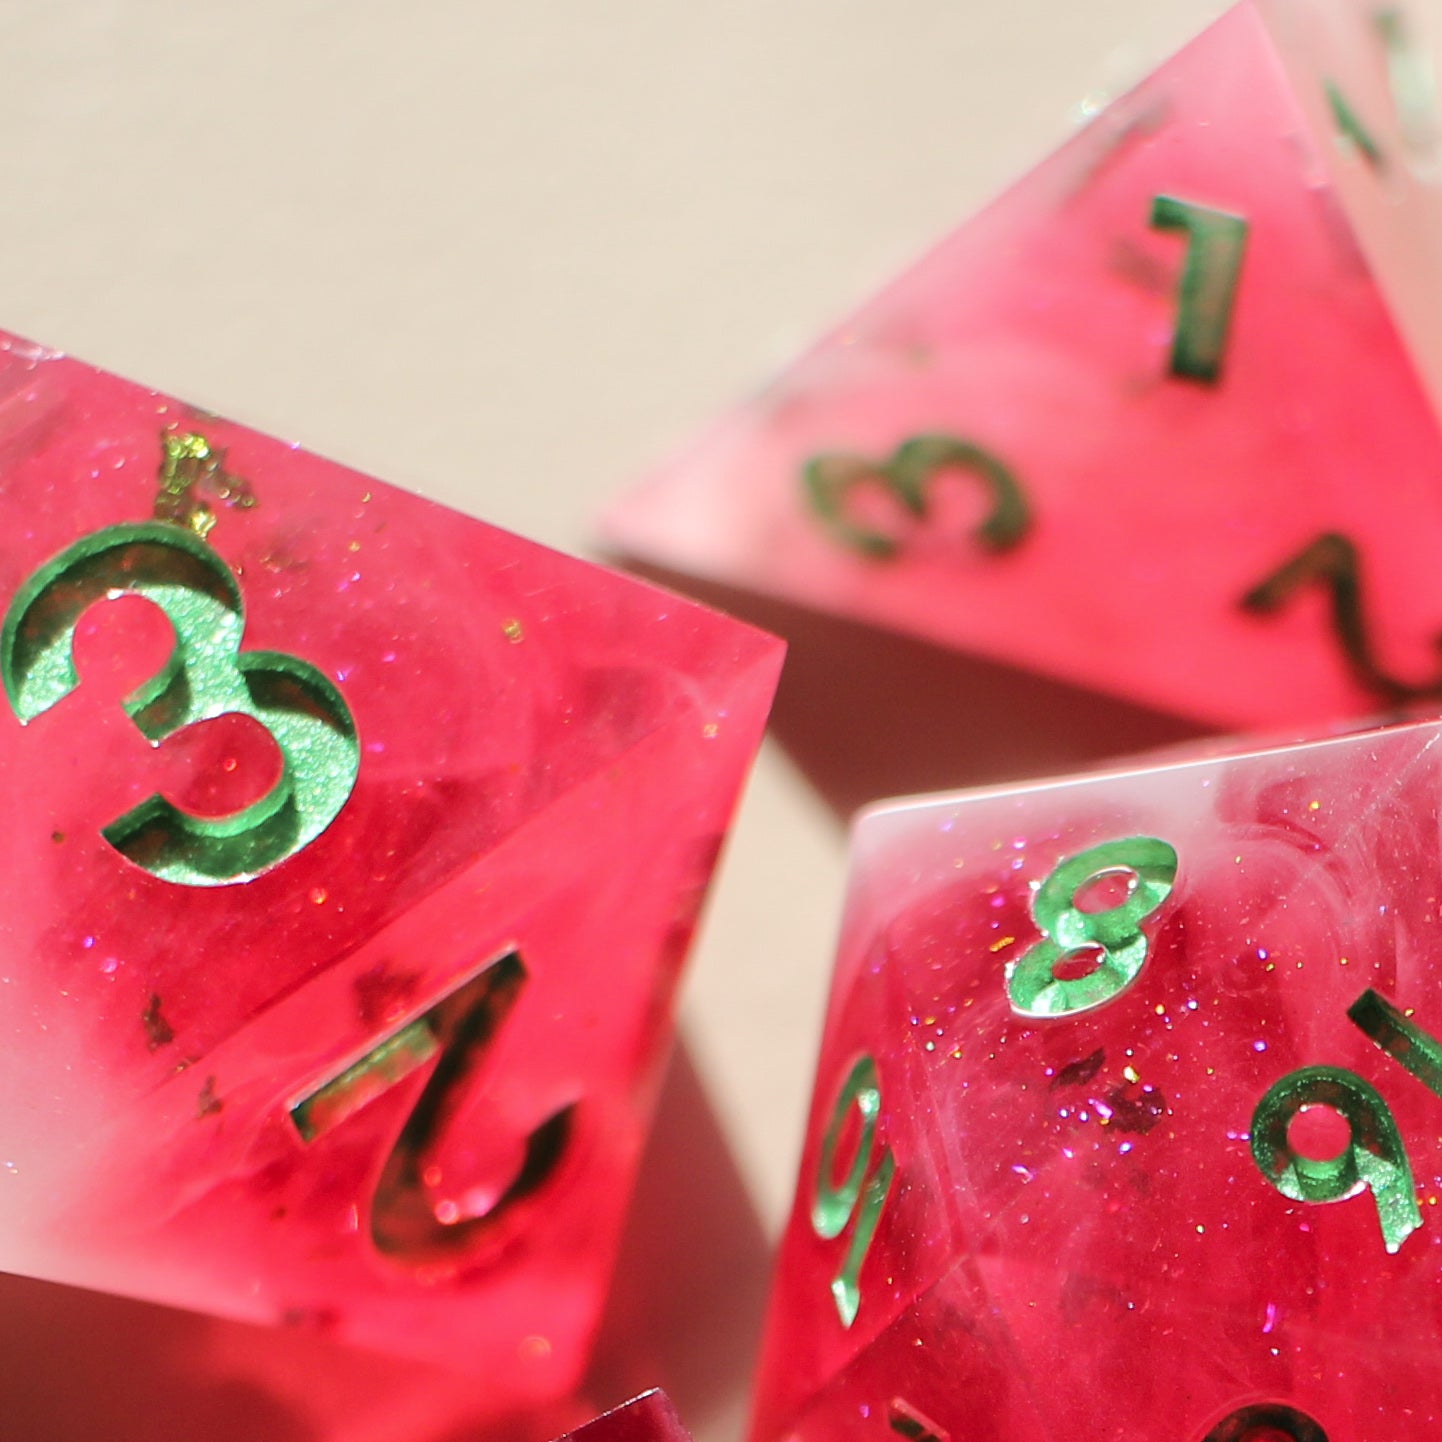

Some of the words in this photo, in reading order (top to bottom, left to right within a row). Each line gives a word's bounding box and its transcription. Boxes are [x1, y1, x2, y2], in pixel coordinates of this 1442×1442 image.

[1148, 194, 1248, 387] 1
[801, 433, 1033, 562] 3
[3, 522, 360, 887] 3
[1005, 834, 1178, 1018] 8
[288, 940, 578, 1260] 2
